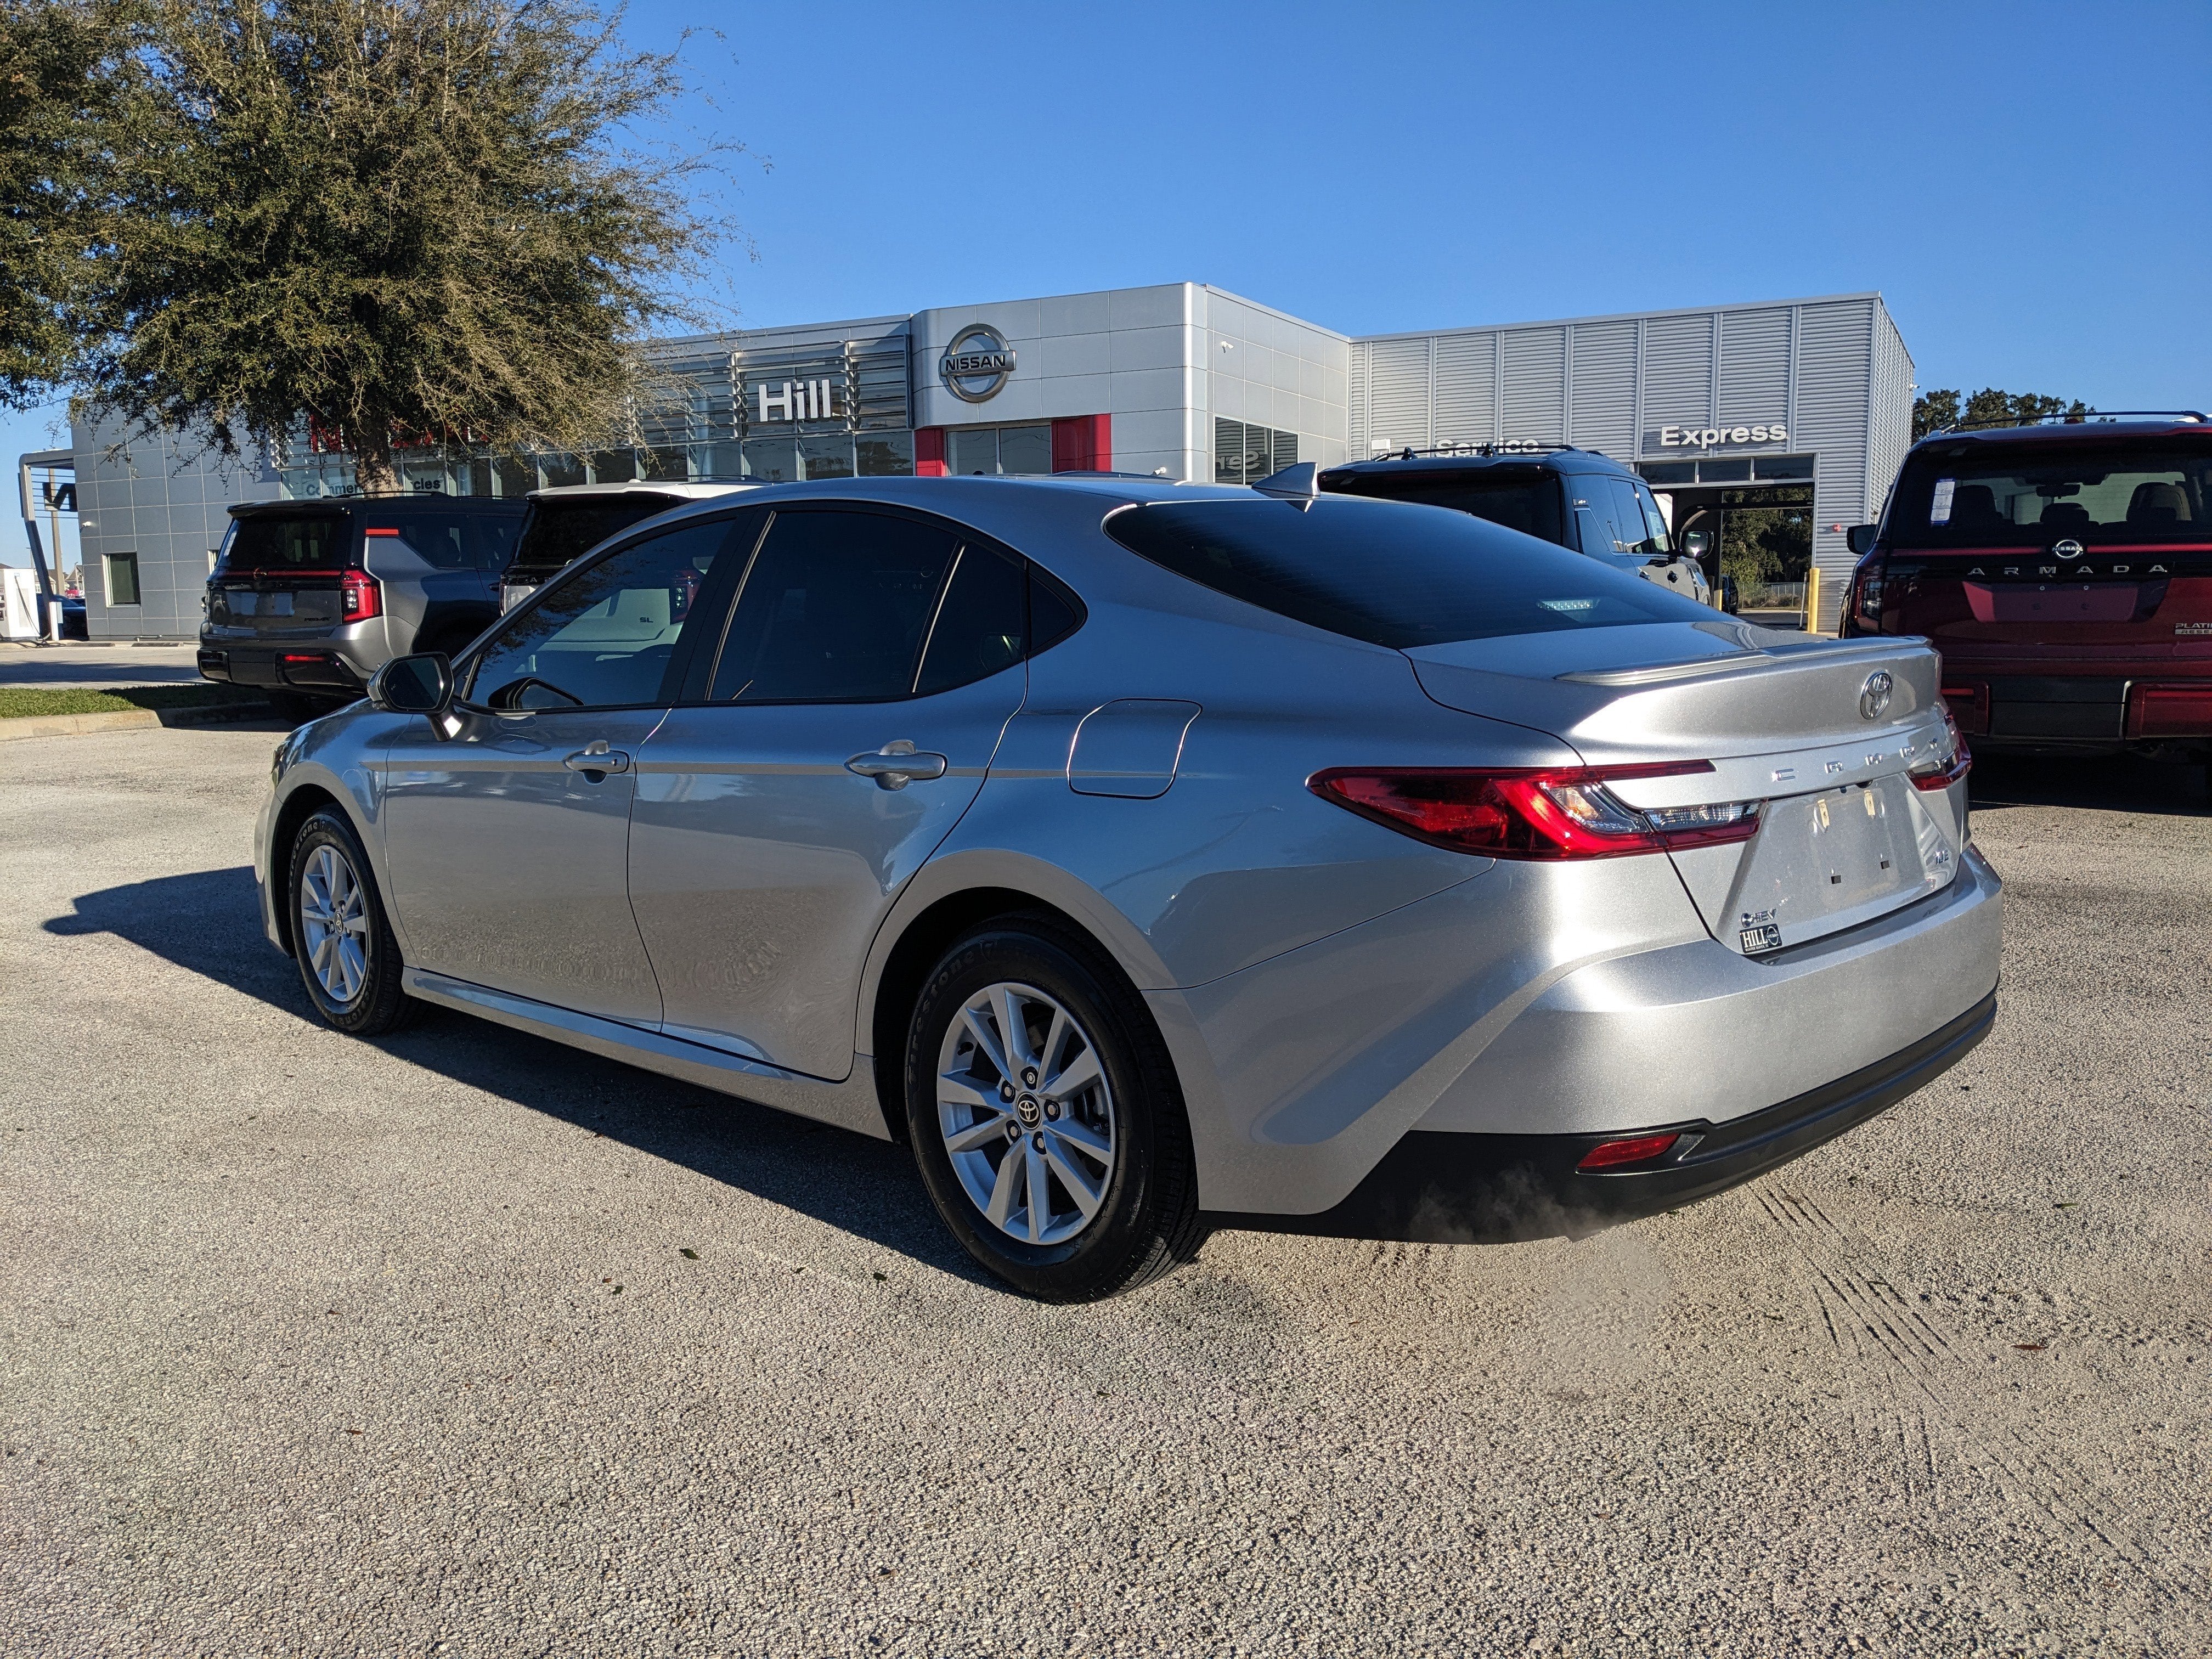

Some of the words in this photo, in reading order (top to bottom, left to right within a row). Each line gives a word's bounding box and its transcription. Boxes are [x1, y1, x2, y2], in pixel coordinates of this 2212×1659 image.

[945, 354, 1006, 371] NISSAN
[759, 379, 832, 422] Hill
[1661, 425, 1788, 449] Express
[1967, 565, 2166, 575] ARMADA
[1771, 738, 1938, 782] CAMRY
[1742, 928, 1768, 948] HILL
